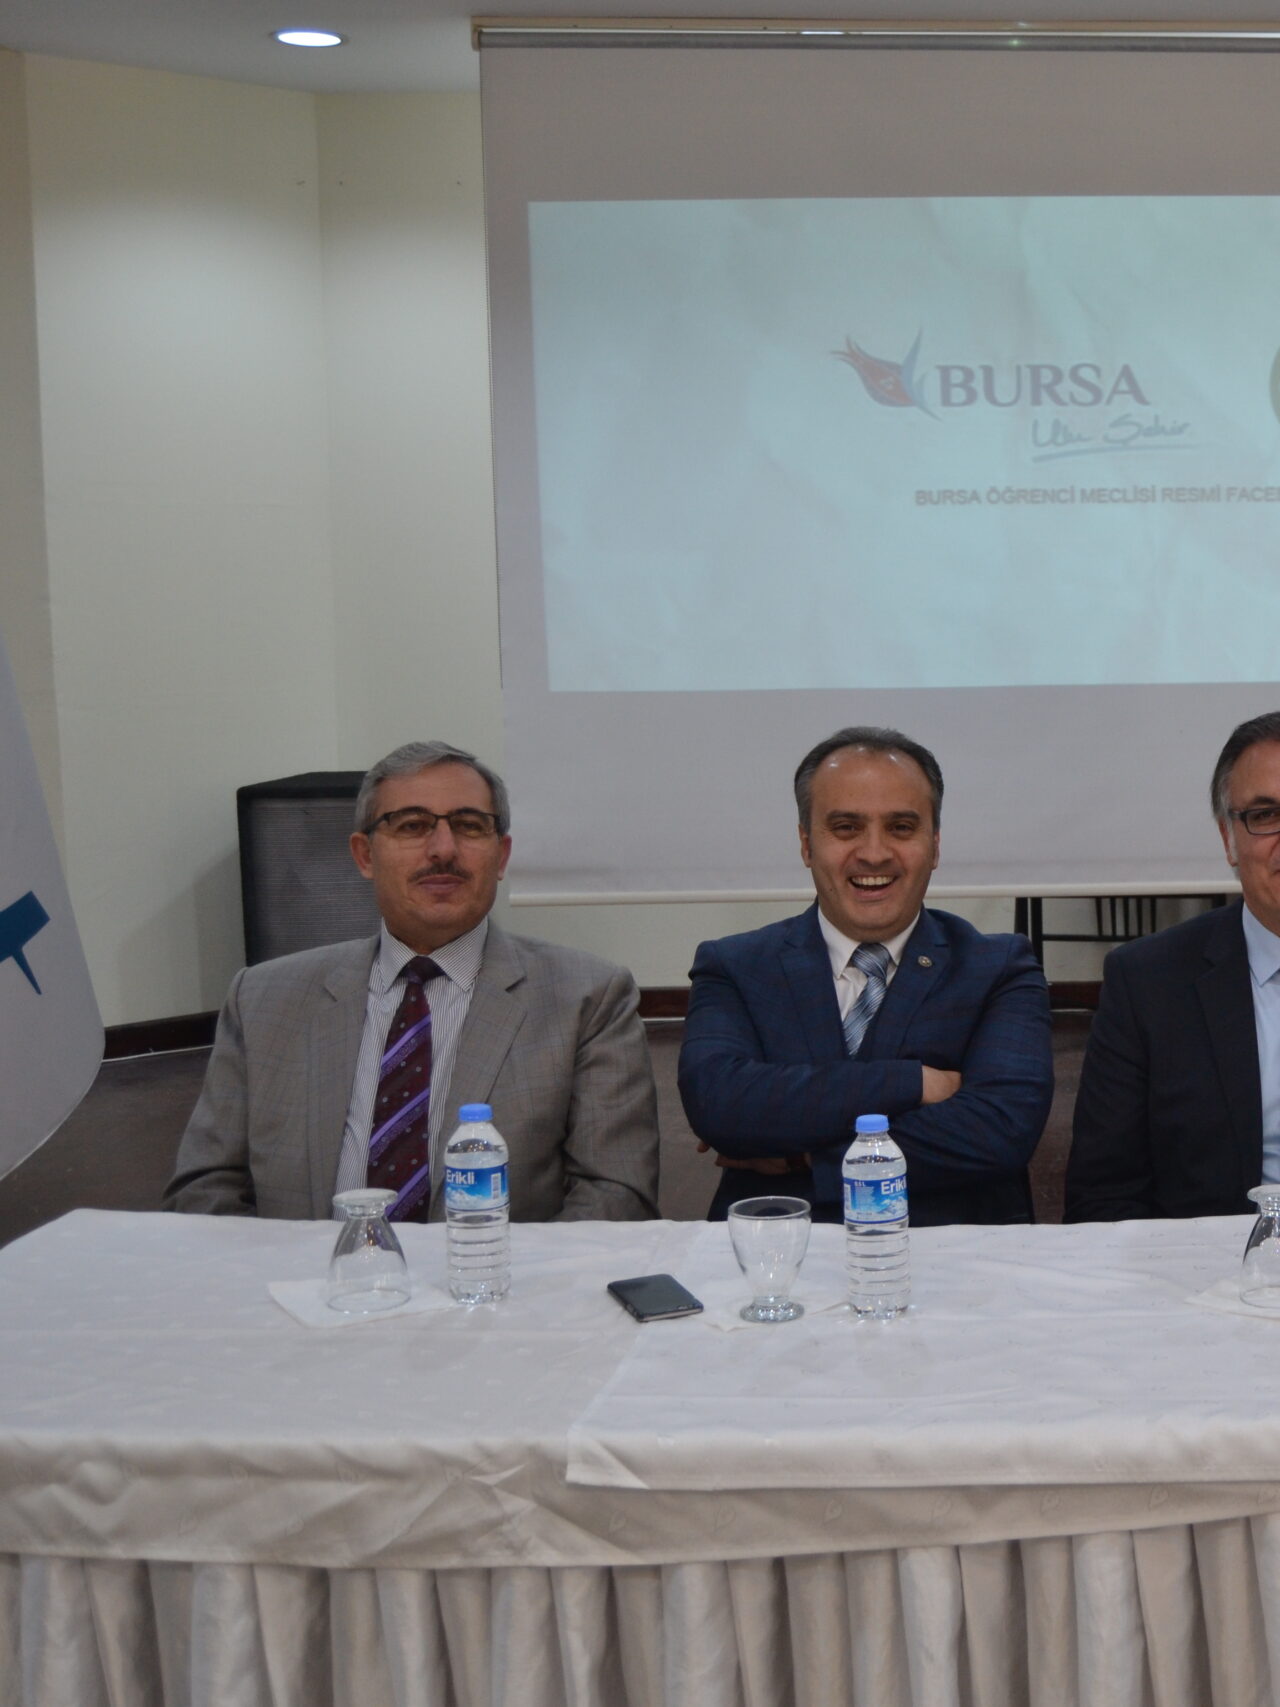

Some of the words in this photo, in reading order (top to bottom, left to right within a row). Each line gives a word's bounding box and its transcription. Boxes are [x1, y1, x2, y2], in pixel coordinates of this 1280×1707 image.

[934, 362, 1151, 408] BURSA
[914, 489, 981, 506] BURSA
[986, 485, 1075, 505] ÖĞRENCİ
[1080, 485, 1156, 504] MECLİSİ
[1161, 485, 1221, 503] RESMİ
[446, 1169, 475, 1185] Erikli
[881, 1175, 908, 1195] Erikl
